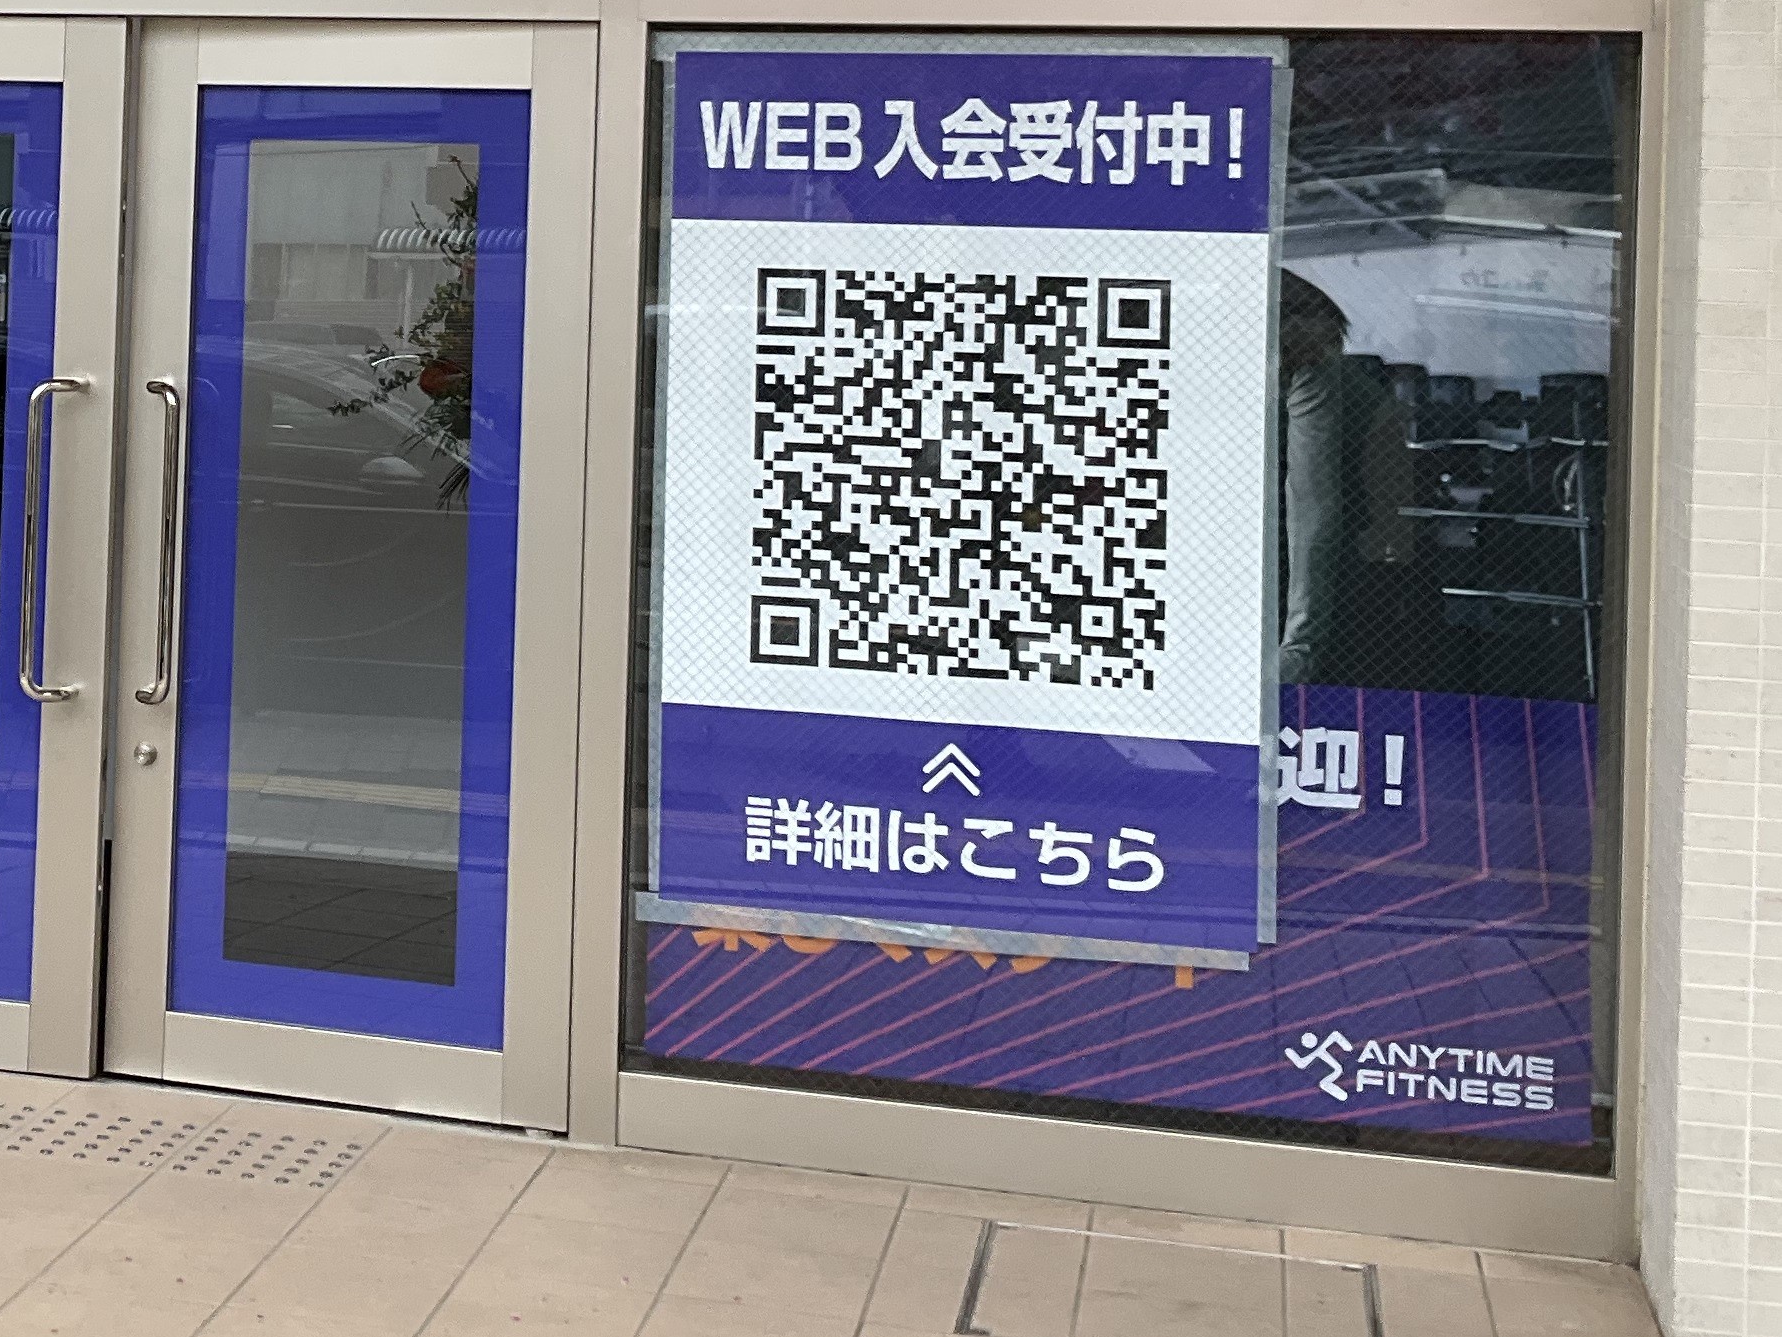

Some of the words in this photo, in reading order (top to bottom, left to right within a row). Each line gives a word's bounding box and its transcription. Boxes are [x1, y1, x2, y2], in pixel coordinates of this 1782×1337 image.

[743, 796, 1166, 893] 詳細はこちら
[1356, 1038, 1555, 1082] ANYTIME
[1355, 1068, 1555, 1111] FITNESS
